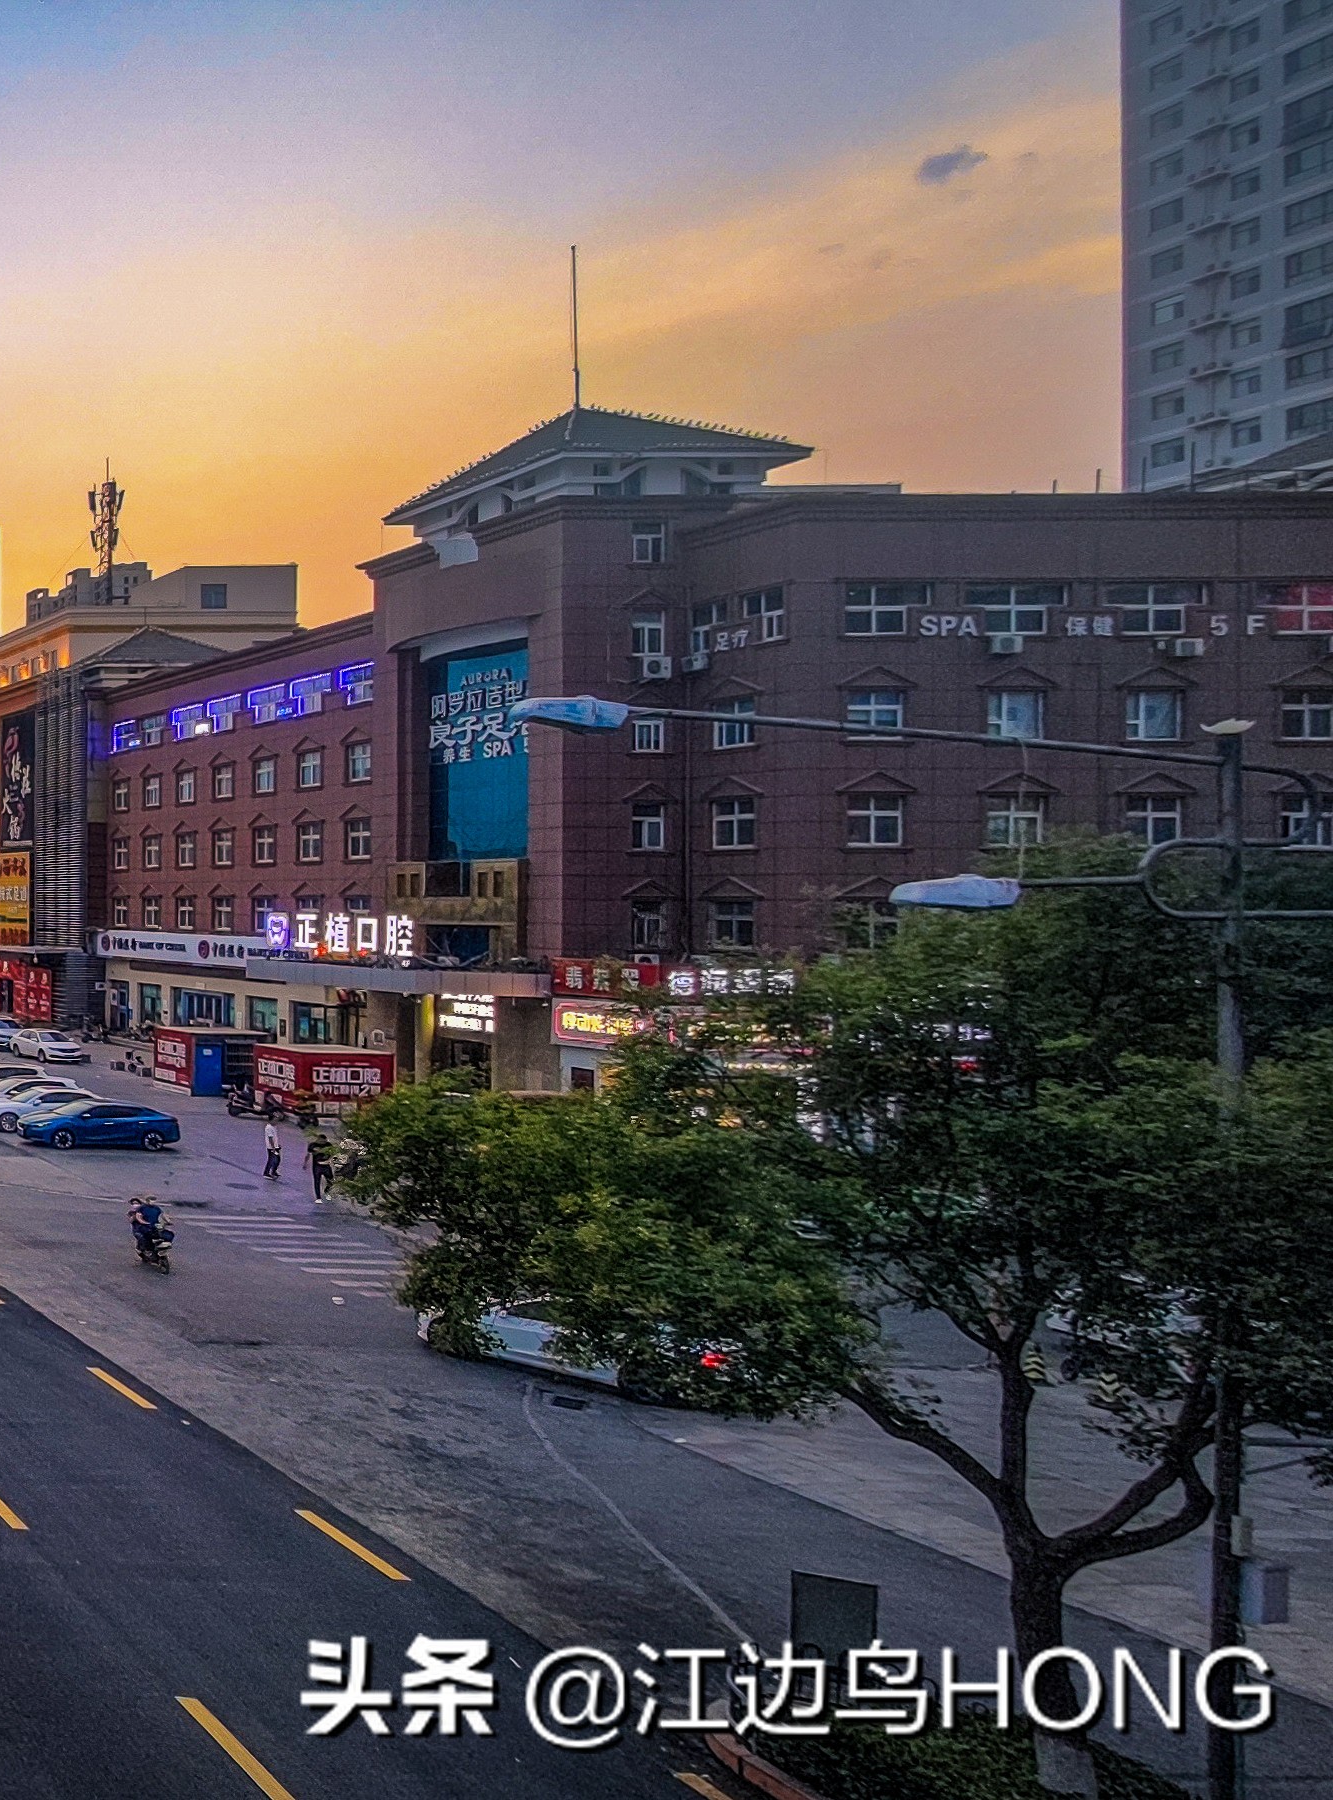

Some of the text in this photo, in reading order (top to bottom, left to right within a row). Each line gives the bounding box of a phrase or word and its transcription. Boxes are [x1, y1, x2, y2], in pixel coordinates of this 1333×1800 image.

[919, 615, 979, 638] SPA
[1065, 615, 1115, 638] 保健
[714, 628, 751, 655] 足疗
[460, 668, 509, 686] AURORA
[431, 681, 523, 719] 阿罗拉造型
[483, 741, 512, 758] SPA
[295, 912, 414, 957] 正植口腔
